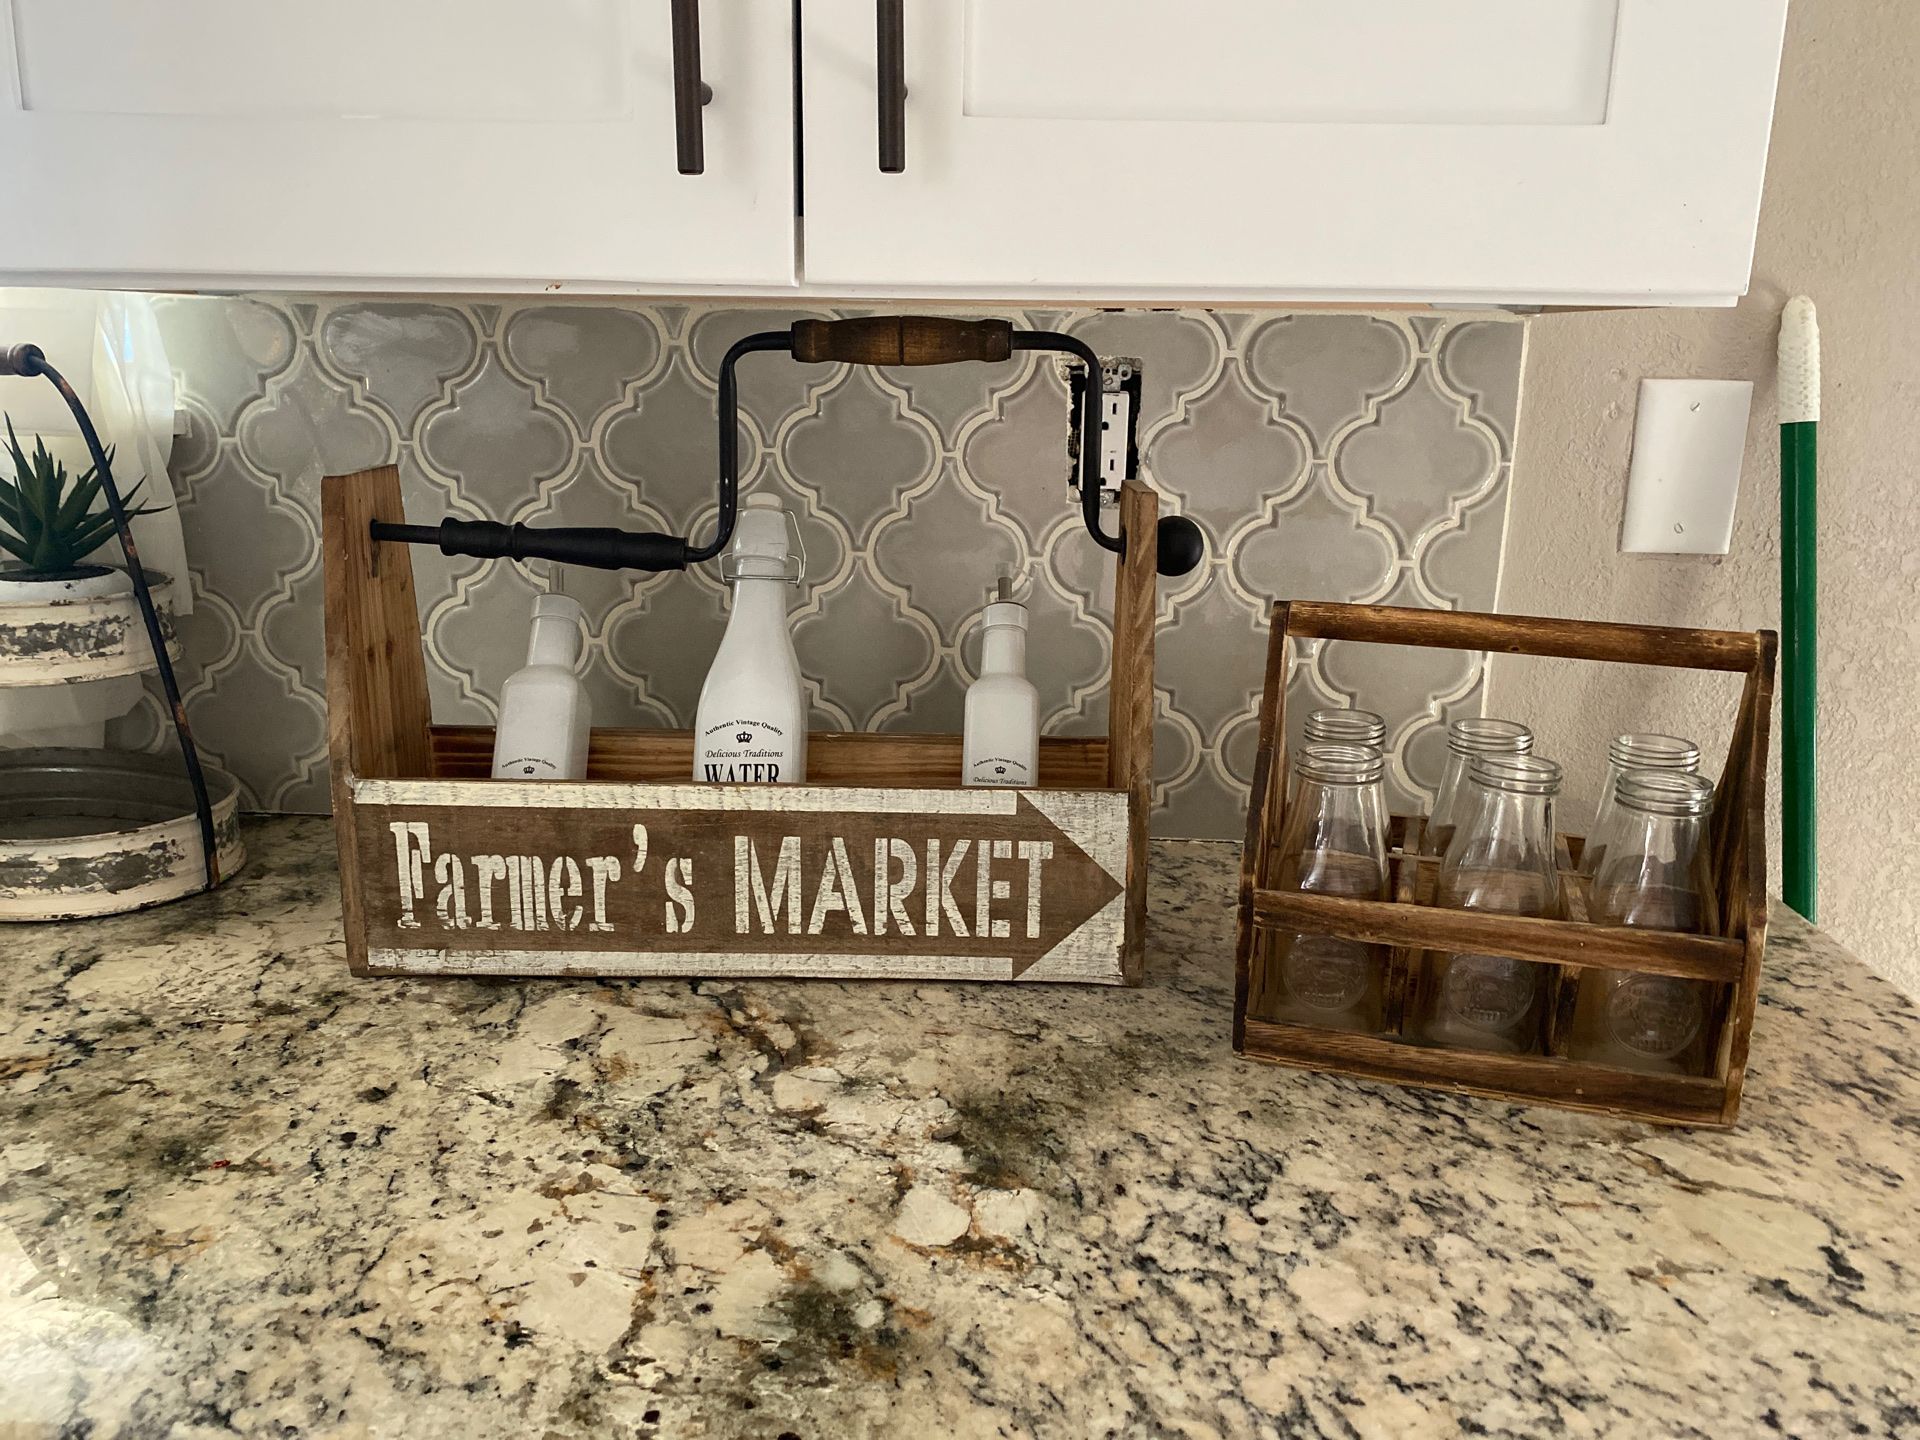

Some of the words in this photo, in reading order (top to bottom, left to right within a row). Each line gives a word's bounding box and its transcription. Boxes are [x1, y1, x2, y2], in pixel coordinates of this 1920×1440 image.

[704, 720, 735, 737] Authentic
[735, 719, 761, 727] Vintage
[761, 721, 784, 736] Quality
[705, 748, 741, 758] Delicious
[743, 748, 784, 758] Traditions
[704, 763, 780, 783] WATER
[389, 821, 695, 934] Farmer's
[734, 835, 1054, 939] MARKET
